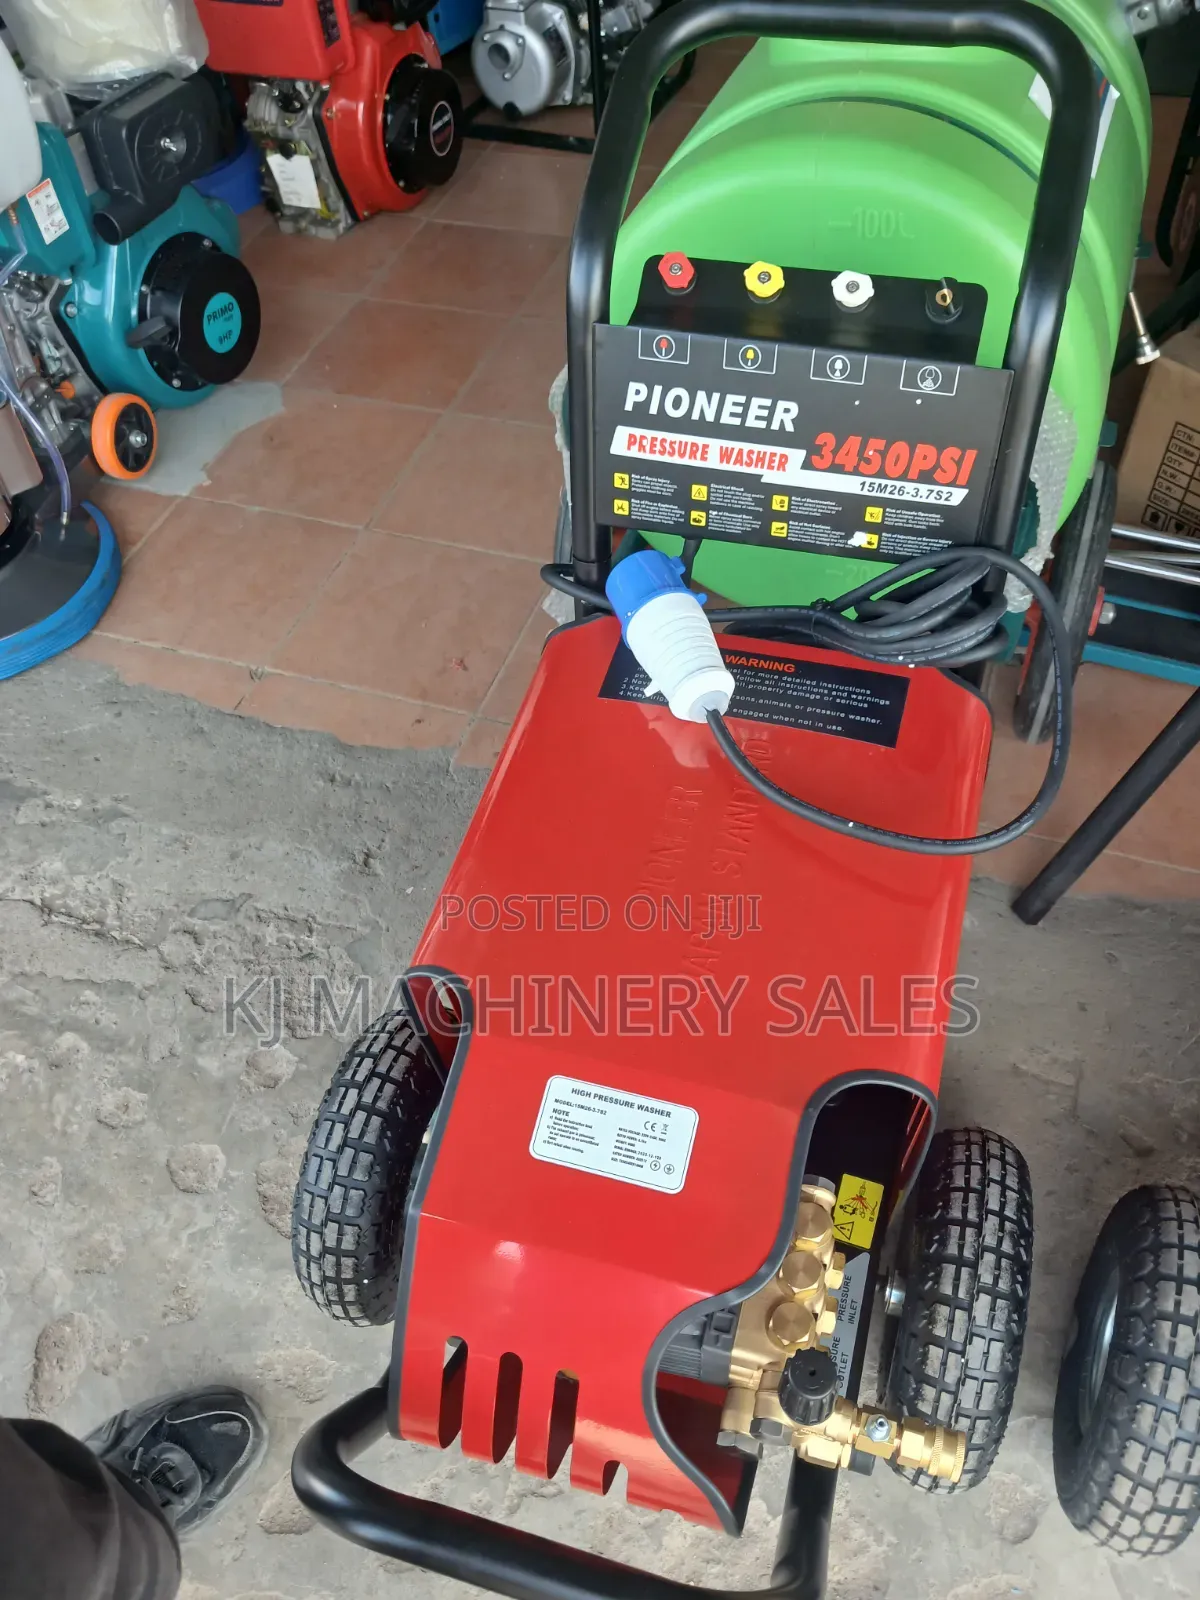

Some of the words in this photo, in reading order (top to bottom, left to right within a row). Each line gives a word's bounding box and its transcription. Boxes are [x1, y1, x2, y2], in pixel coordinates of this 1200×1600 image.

[206, 302, 234, 326] PRIMO
[624, 381, 799, 432] PIONEER
[627, 433, 710, 462] PRESSURE
[719, 445, 789, 472] WASHER
[811, 432, 978, 486] 3450PSI
[859, 480, 953, 502] 15M26-3.7S2
[725, 654, 796, 673] WARNING
[736, 674, 761, 683] follow
[778, 681, 829, 694] instructions
[831, 690, 847, 698] and
[851, 694, 890, 706] warnings
[758, 672, 779, 680] more
[782, 674, 817, 686] detailed
[819, 681, 871, 695] instructions
[787, 688, 821, 701] damage
[836, 697, 869, 708] serious
[732, 708, 770, 718] engaged
[773, 714, 796, 723] when
[798, 718, 812, 727] not
[826, 723, 846, 732] use.
[806, 706, 846, 719] pressure
[849, 713, 884, 726] washer.
[552, 1108, 570, 1117] NOTE
[571, 1087, 592, 1098] HIGH
[593, 1093, 635, 1109] PRESSURE
[636, 1103, 672, 1118] WASHER
[837, 1274, 852, 1322] PRESSURE
[847, 1299, 858, 1325] INLET
[830, 1336, 841, 1363] SURE
